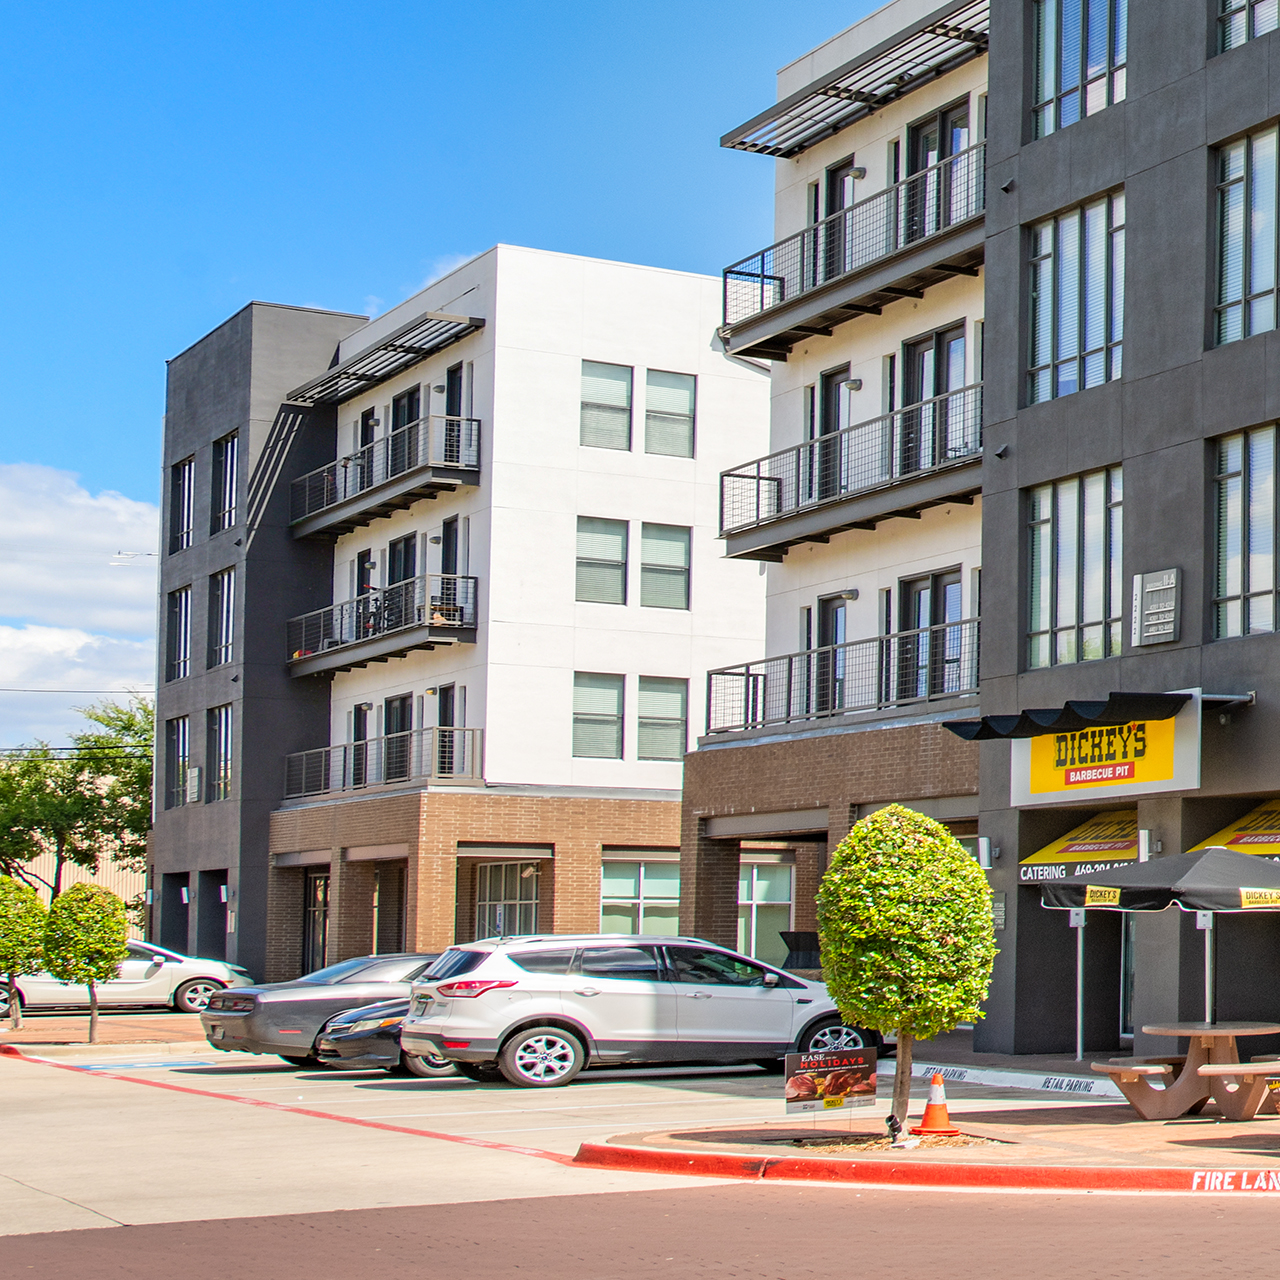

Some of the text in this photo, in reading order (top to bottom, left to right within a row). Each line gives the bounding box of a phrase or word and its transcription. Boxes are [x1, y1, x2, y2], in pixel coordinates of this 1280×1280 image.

[1055, 722, 1147, 768] DICKEY'S
[1069, 765, 1130, 782] BARBECUE PIT
[1020, 865, 1067, 880] CATERING
[1089, 888, 1117, 899] DICKEY'S
[1245, 891, 1280, 900] DICKEY'S
[800, 1057, 864, 1069] HOLIDAYS
[802, 1053, 825, 1062] EASE
[943, 1068, 968, 1080] PARKING
[1041, 1077, 1095, 1092] RETAIL PARKING
[1192, 1171, 1236, 1191] FIRE
